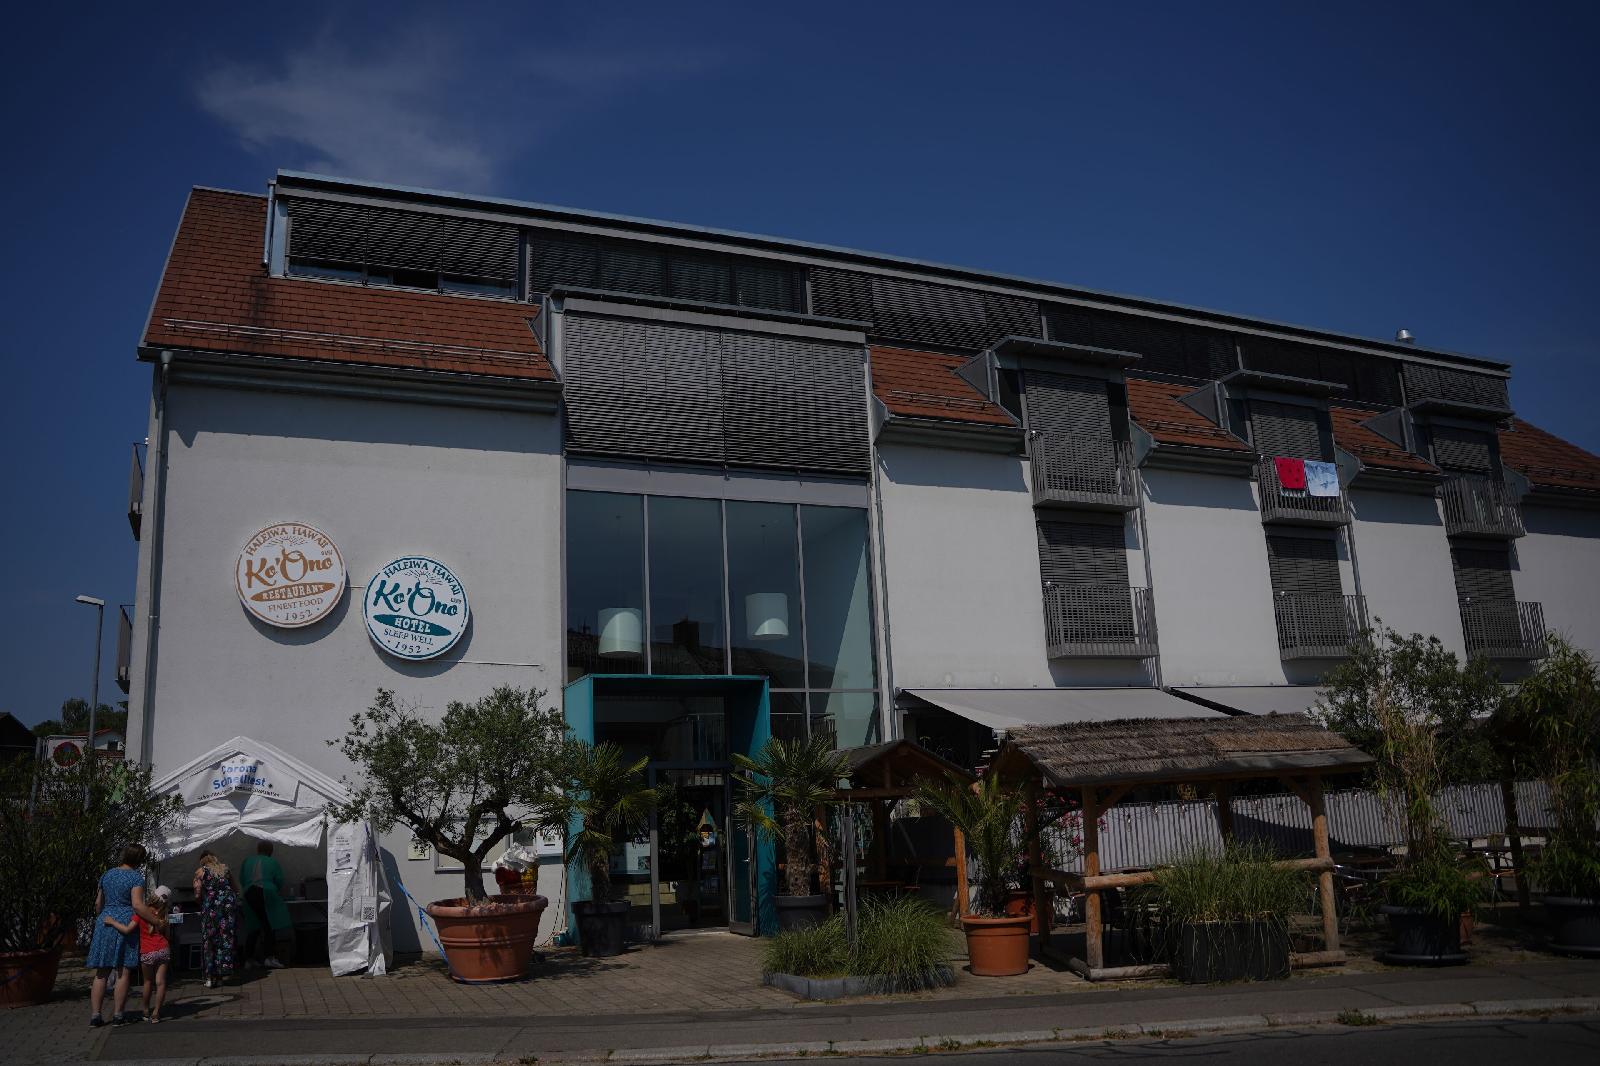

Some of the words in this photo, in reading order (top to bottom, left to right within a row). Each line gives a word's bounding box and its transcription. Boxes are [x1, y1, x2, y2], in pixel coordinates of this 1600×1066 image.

[245, 527, 288, 556] HALEIWA
[292, 527, 328, 548] HAWAII
[384, 561, 428, 578] HALEIWA
[432, 566, 461, 595] HAWAII
[262, 585, 324, 599] RESTAURANT
[268, 602, 297, 611] FINEST
[299, 598, 323, 606] FOOD
[285, 610, 313, 621] 1952
[394, 617, 431, 633] HOTEL
[384, 628, 408, 640] SLEEP
[411, 634, 434, 645] WELL
[395, 641, 421, 653] 1952
[221, 765, 257, 774] Corona
